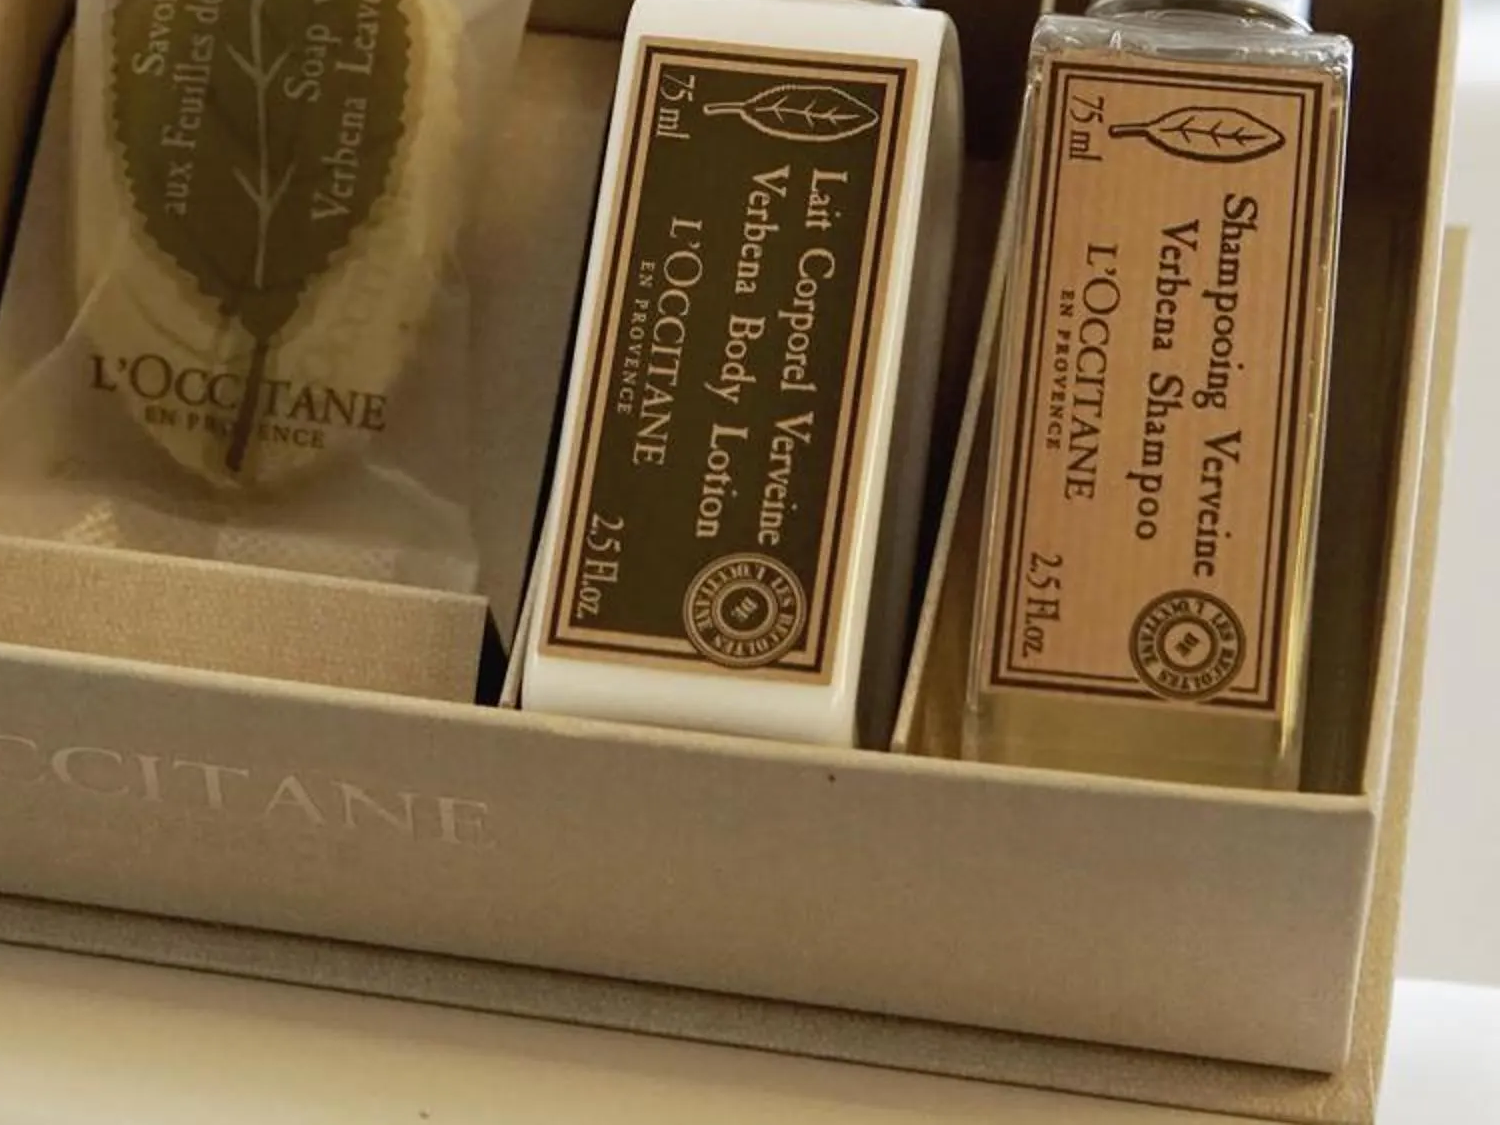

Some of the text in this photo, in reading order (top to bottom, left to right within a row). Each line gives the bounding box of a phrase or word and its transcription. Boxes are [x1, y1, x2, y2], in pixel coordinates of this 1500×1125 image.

[162, 33, 215, 148] Feuilles
[284, 24, 341, 102] Soap
[657, 74, 695, 140] 75 ml
[165, 163, 194, 216] aux
[311, 96, 367, 221] Verbena
[1068, 95, 1104, 161] 75 ml
[90, 354, 387, 431] L'OCCTANE
[617, 260, 656, 414] EN PROVENCE
[696, 164, 791, 538] Verbena Body Lotion
[758, 168, 848, 546] Lait Corporel Verveine
[1046, 289, 1075, 450] EN PROVENCE
[1125, 219, 1200, 540] Verbena Shampoo
[1192, 192, 1259, 577] Shampooing Verveine
